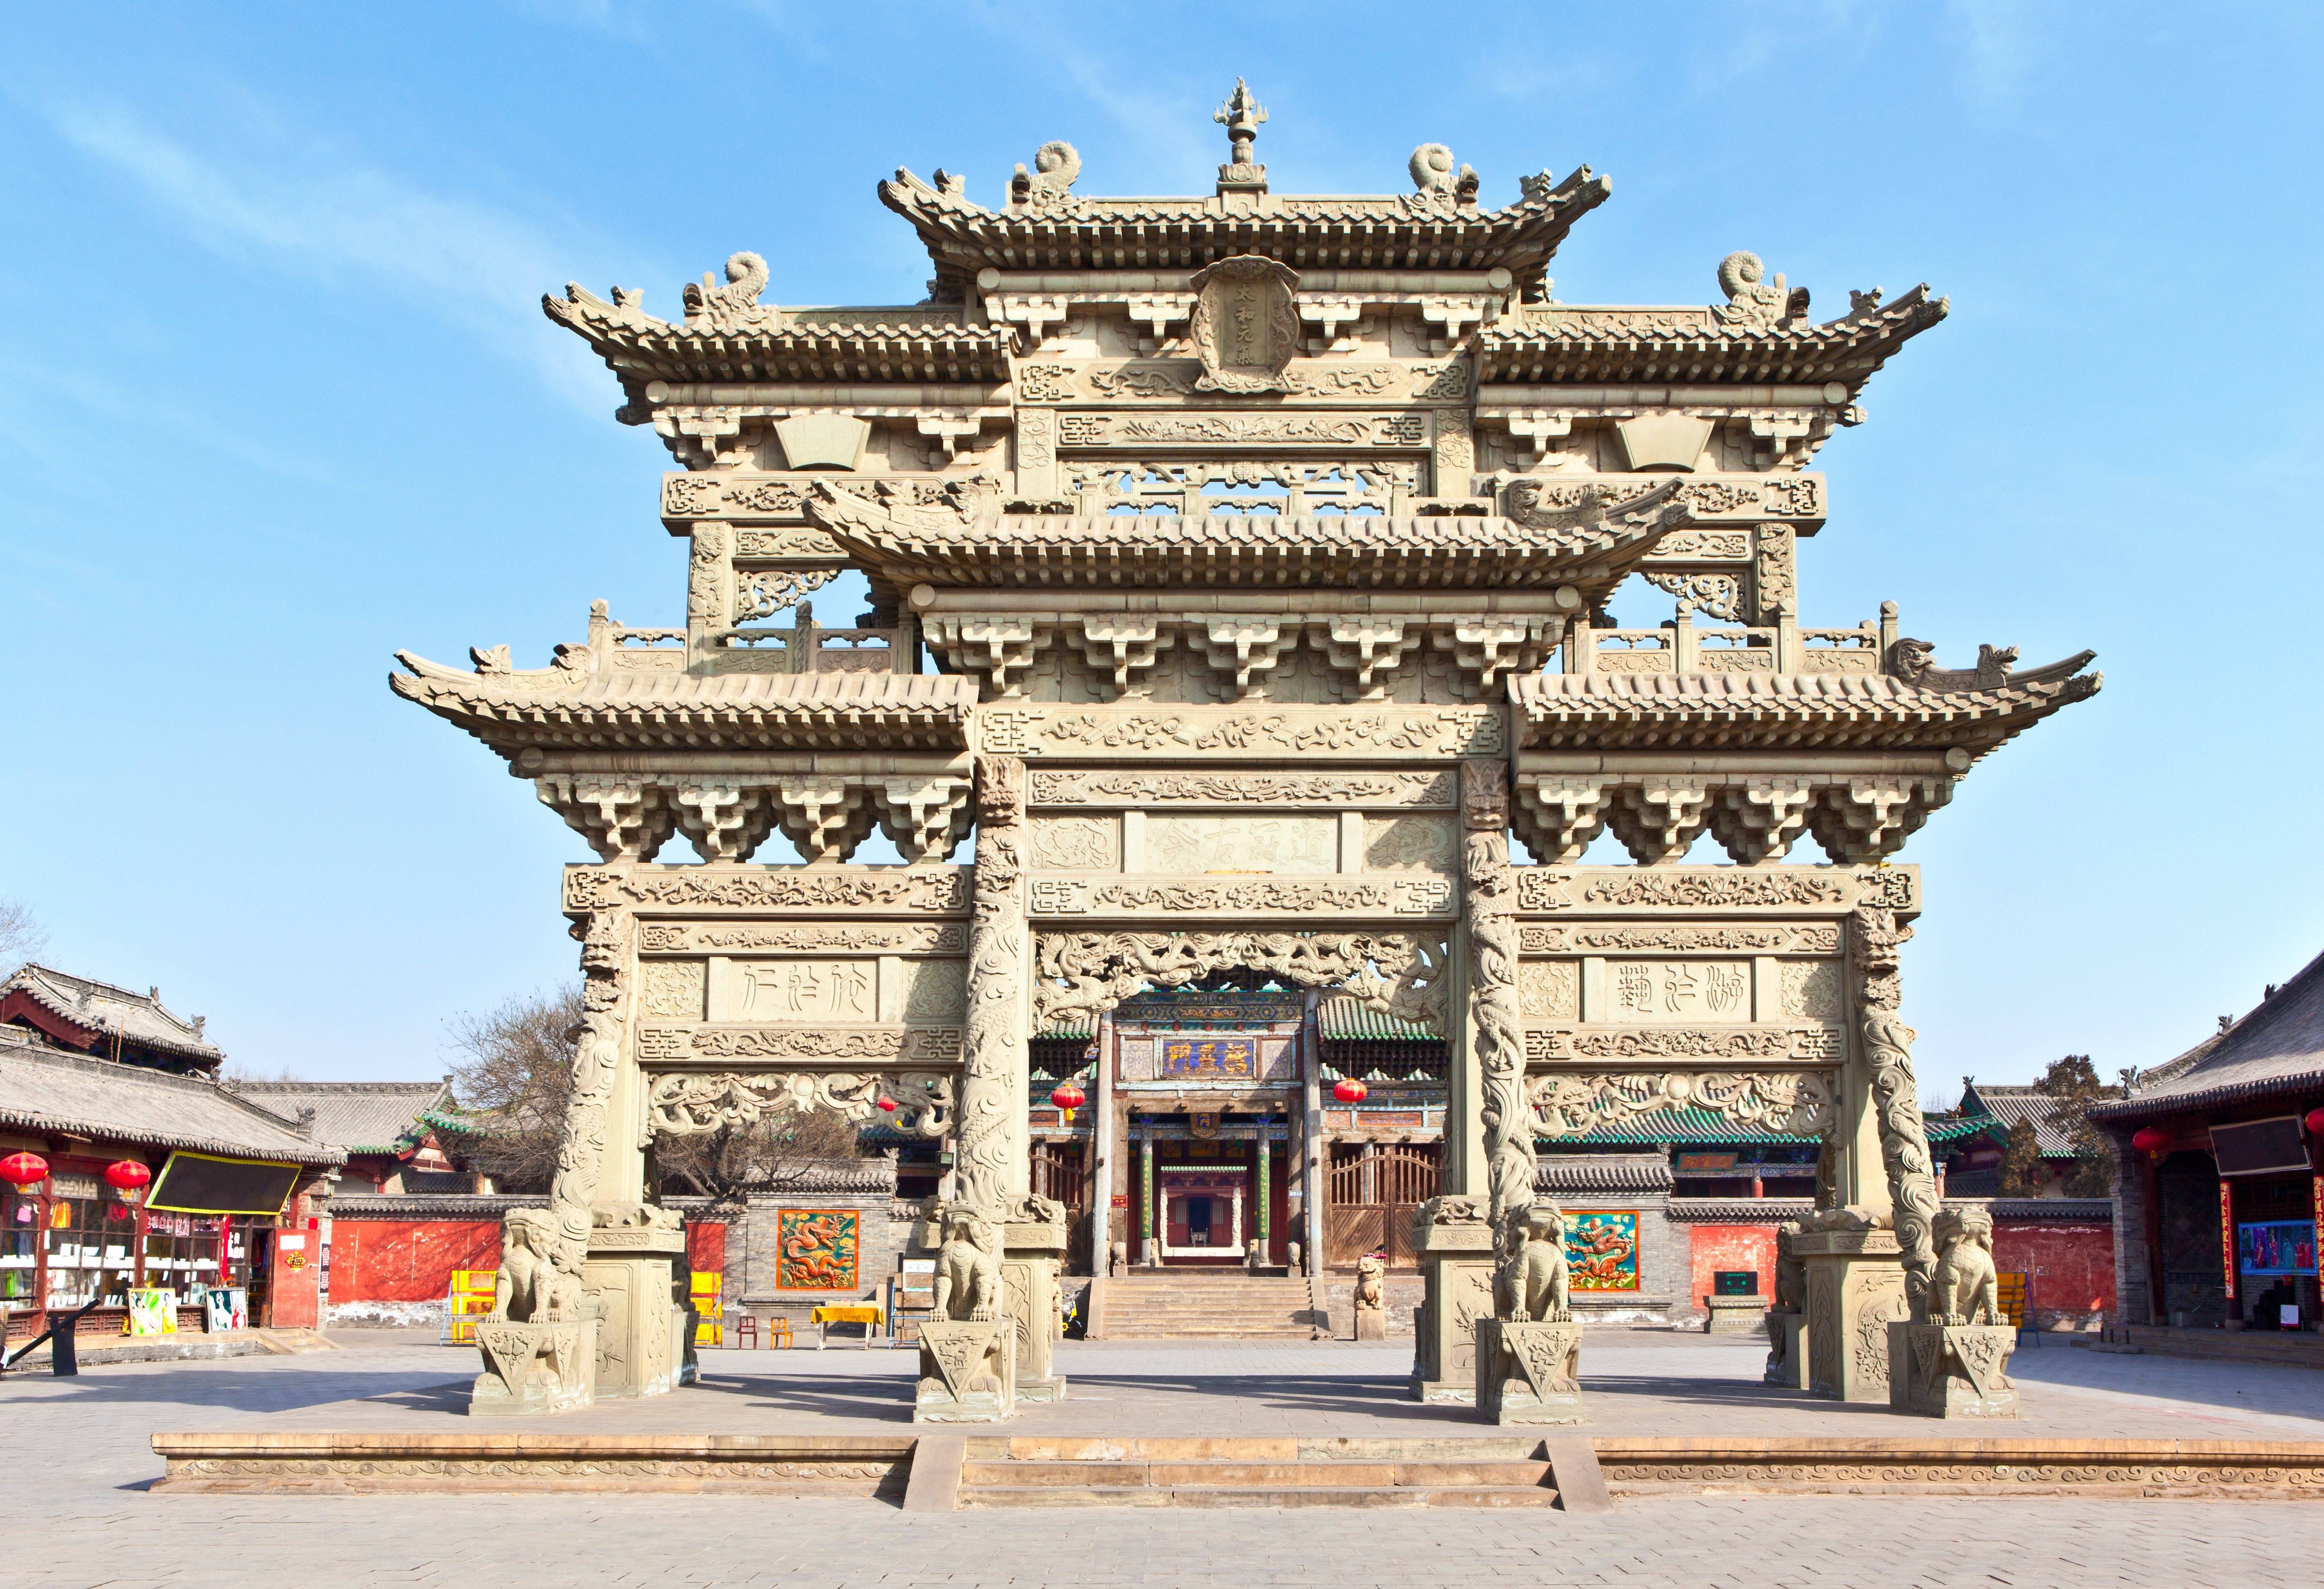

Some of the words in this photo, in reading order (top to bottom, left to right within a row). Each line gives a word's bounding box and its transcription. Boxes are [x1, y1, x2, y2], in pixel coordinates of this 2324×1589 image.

[1234, 283, 1256, 366] 太和元氣
[291, 1256, 301, 1267] 福
